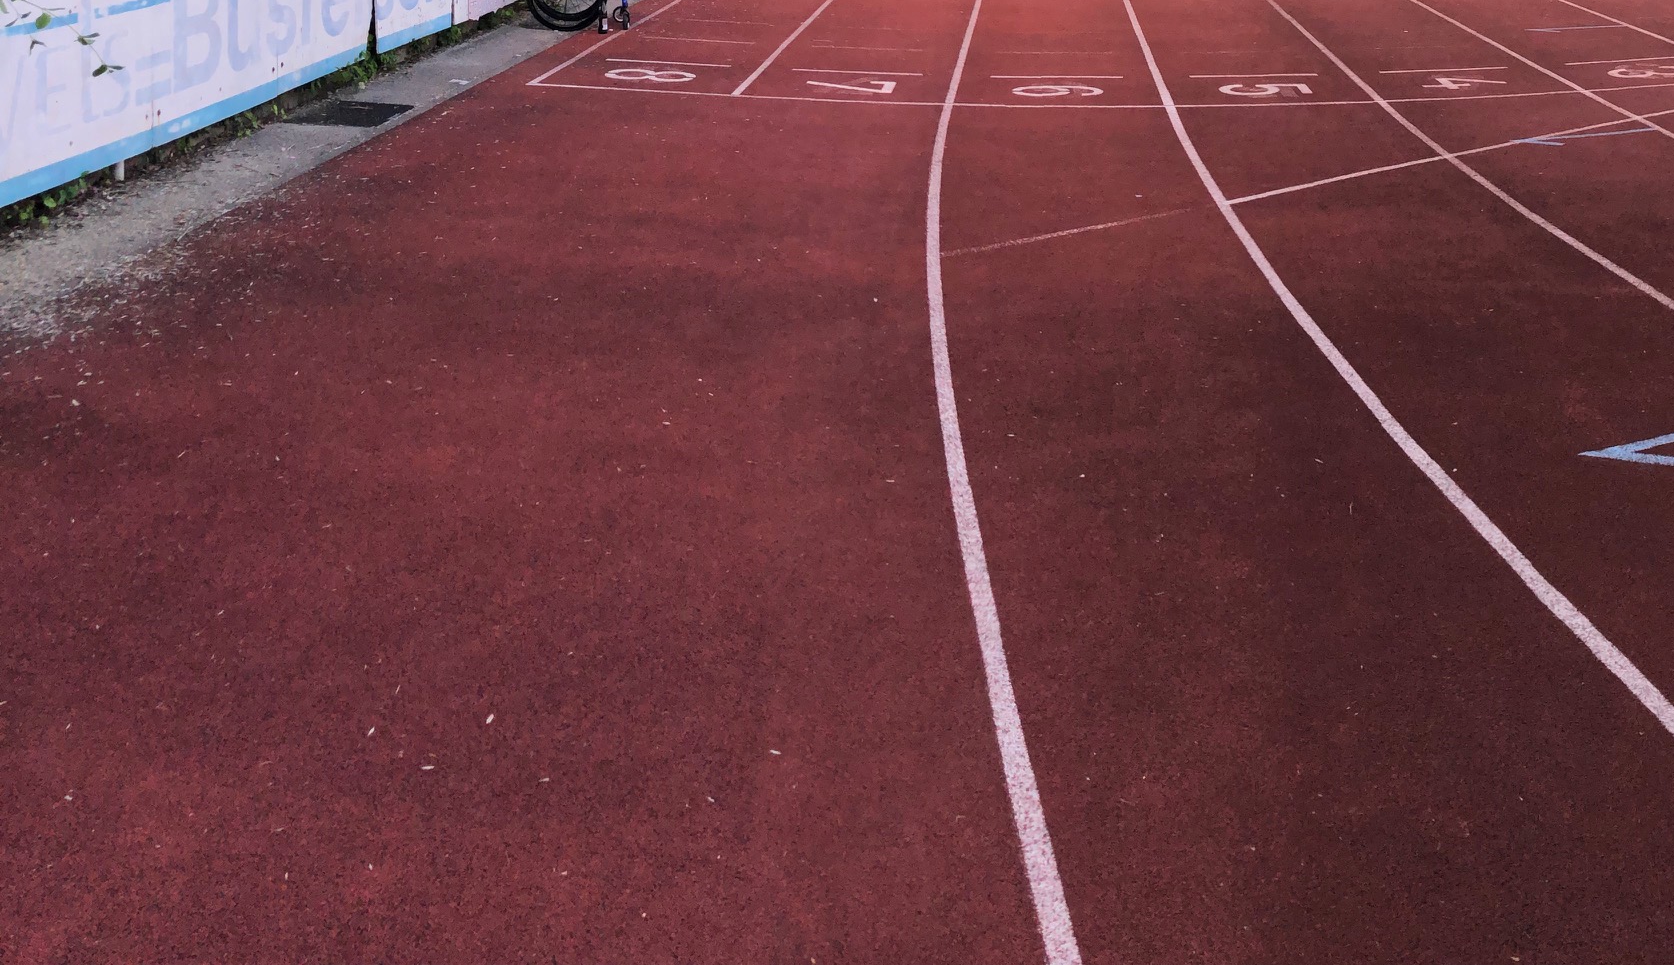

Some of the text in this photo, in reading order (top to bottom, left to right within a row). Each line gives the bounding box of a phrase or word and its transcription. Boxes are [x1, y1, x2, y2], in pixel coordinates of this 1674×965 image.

[604, 68, 697, 82] 8
[806, 80, 897, 94] 7
[1218, 83, 1314, 96] 5
[1422, 77, 1507, 90] 4
[1012, 85, 1104, 97] 6
